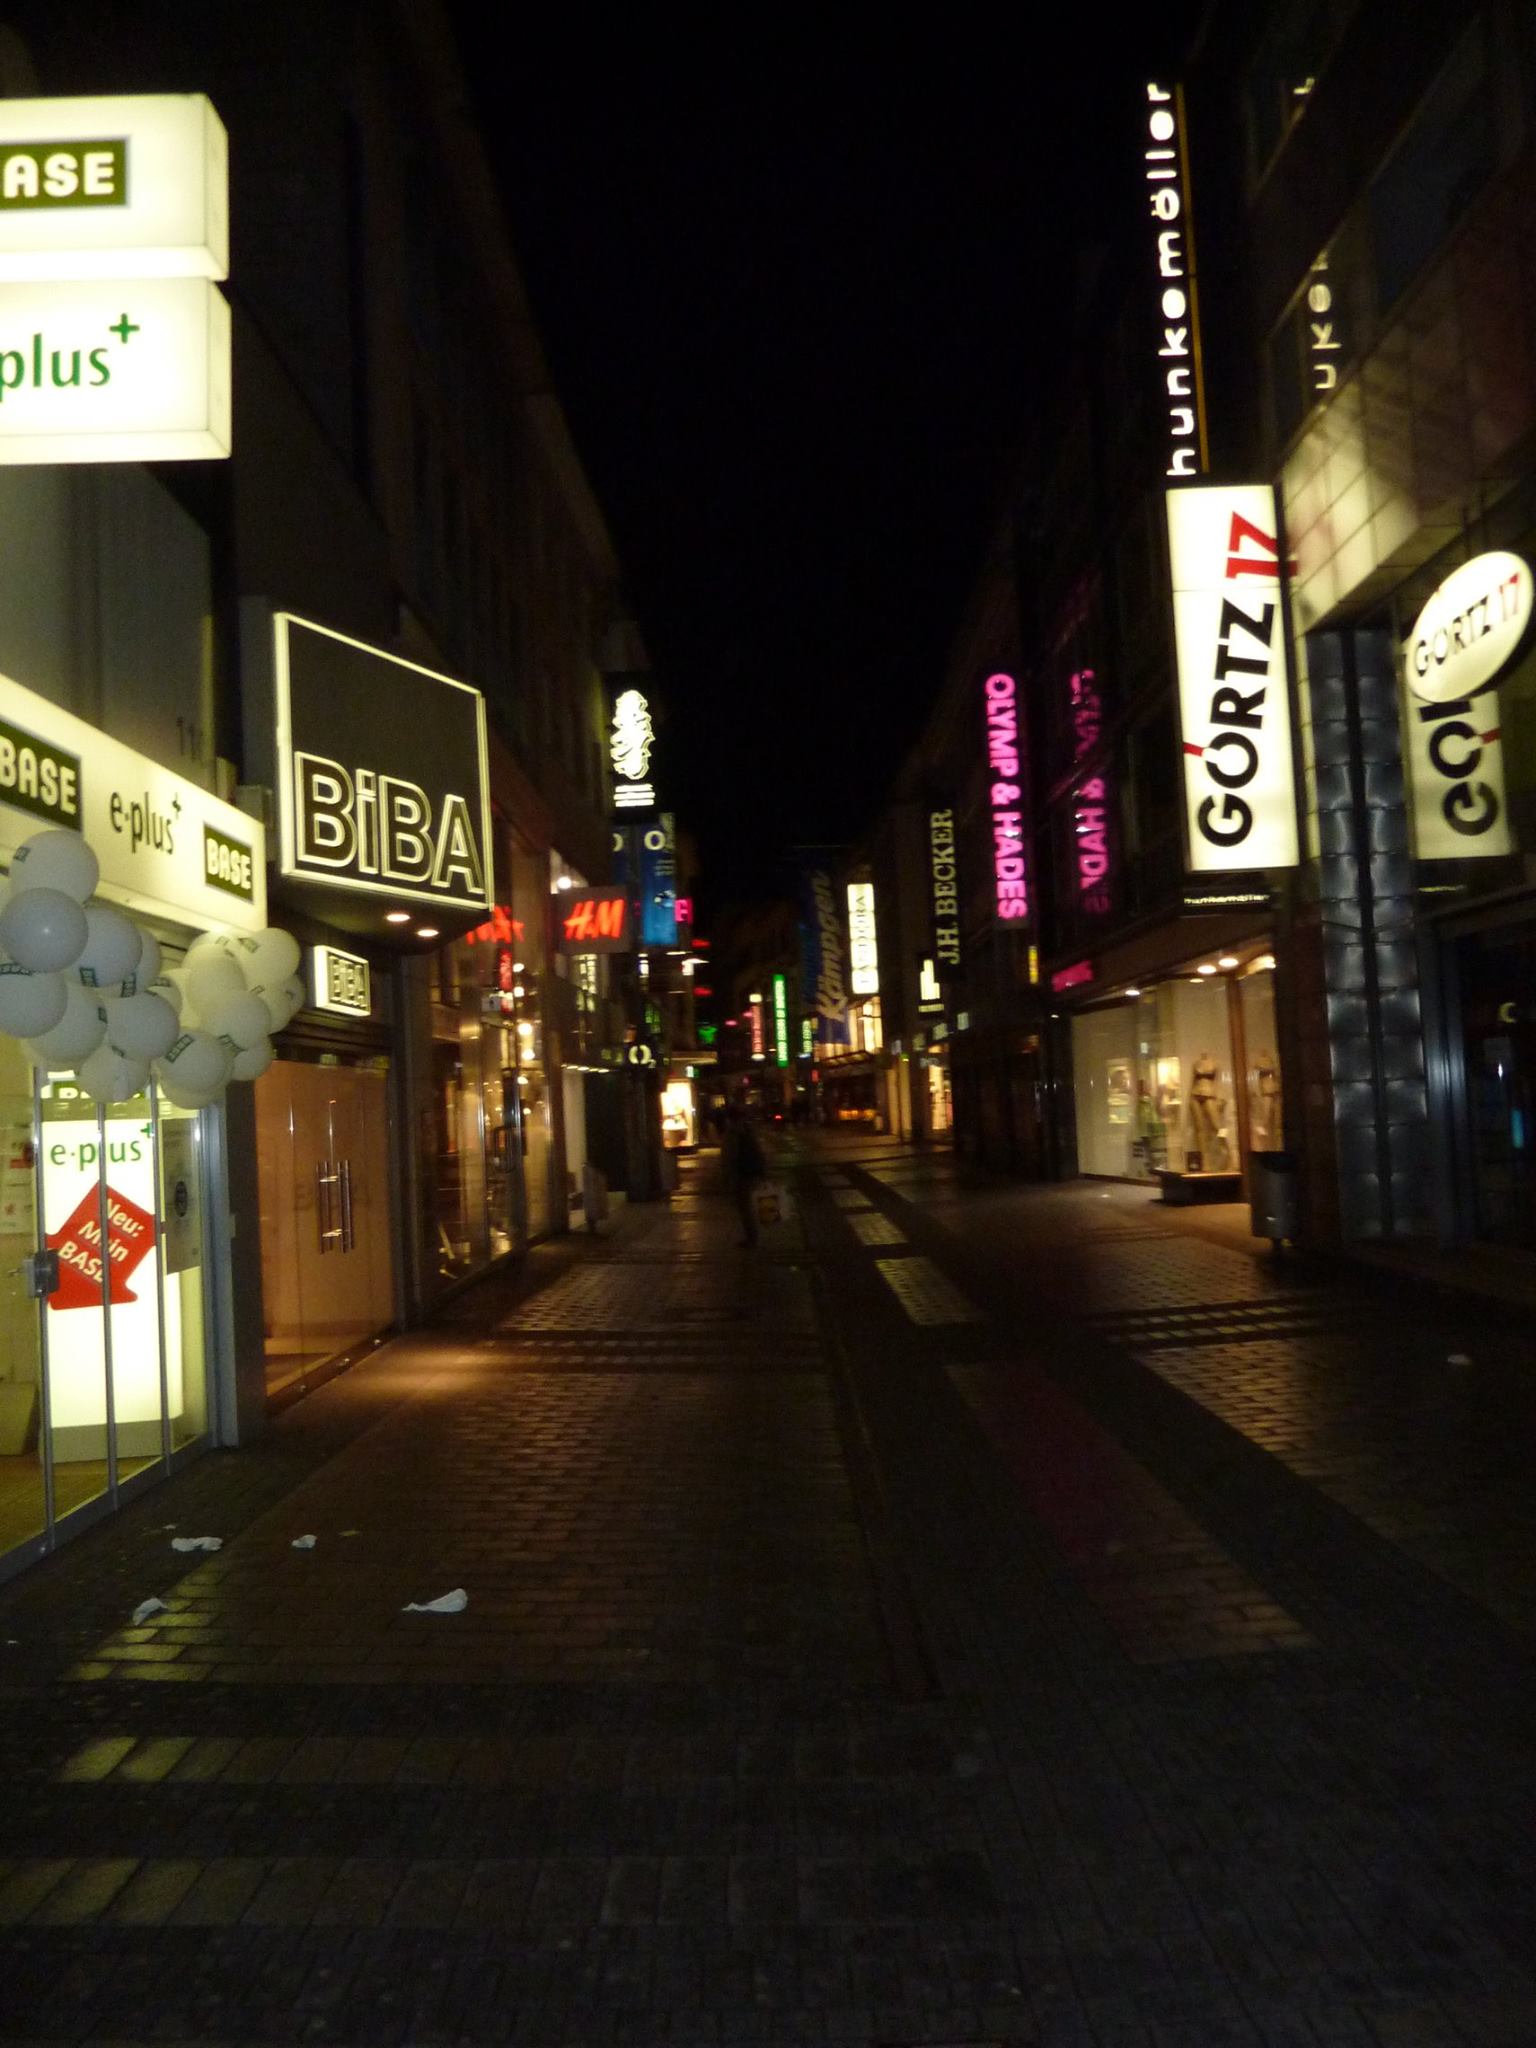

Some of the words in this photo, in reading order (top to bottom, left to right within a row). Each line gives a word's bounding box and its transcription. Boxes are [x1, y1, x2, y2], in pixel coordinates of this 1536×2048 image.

[1225, 511, 1299, 579] 17
[985, 673, 1018, 777] OLYMP
[0, 733, 78, 816] BASE
[991, 783, 1021, 806] &
[205, 837, 252, 891] BASE
[930, 808, 958, 915] BECKER
[993, 812, 1028, 919] HADES
[78, 1220, 130, 1263] Min
